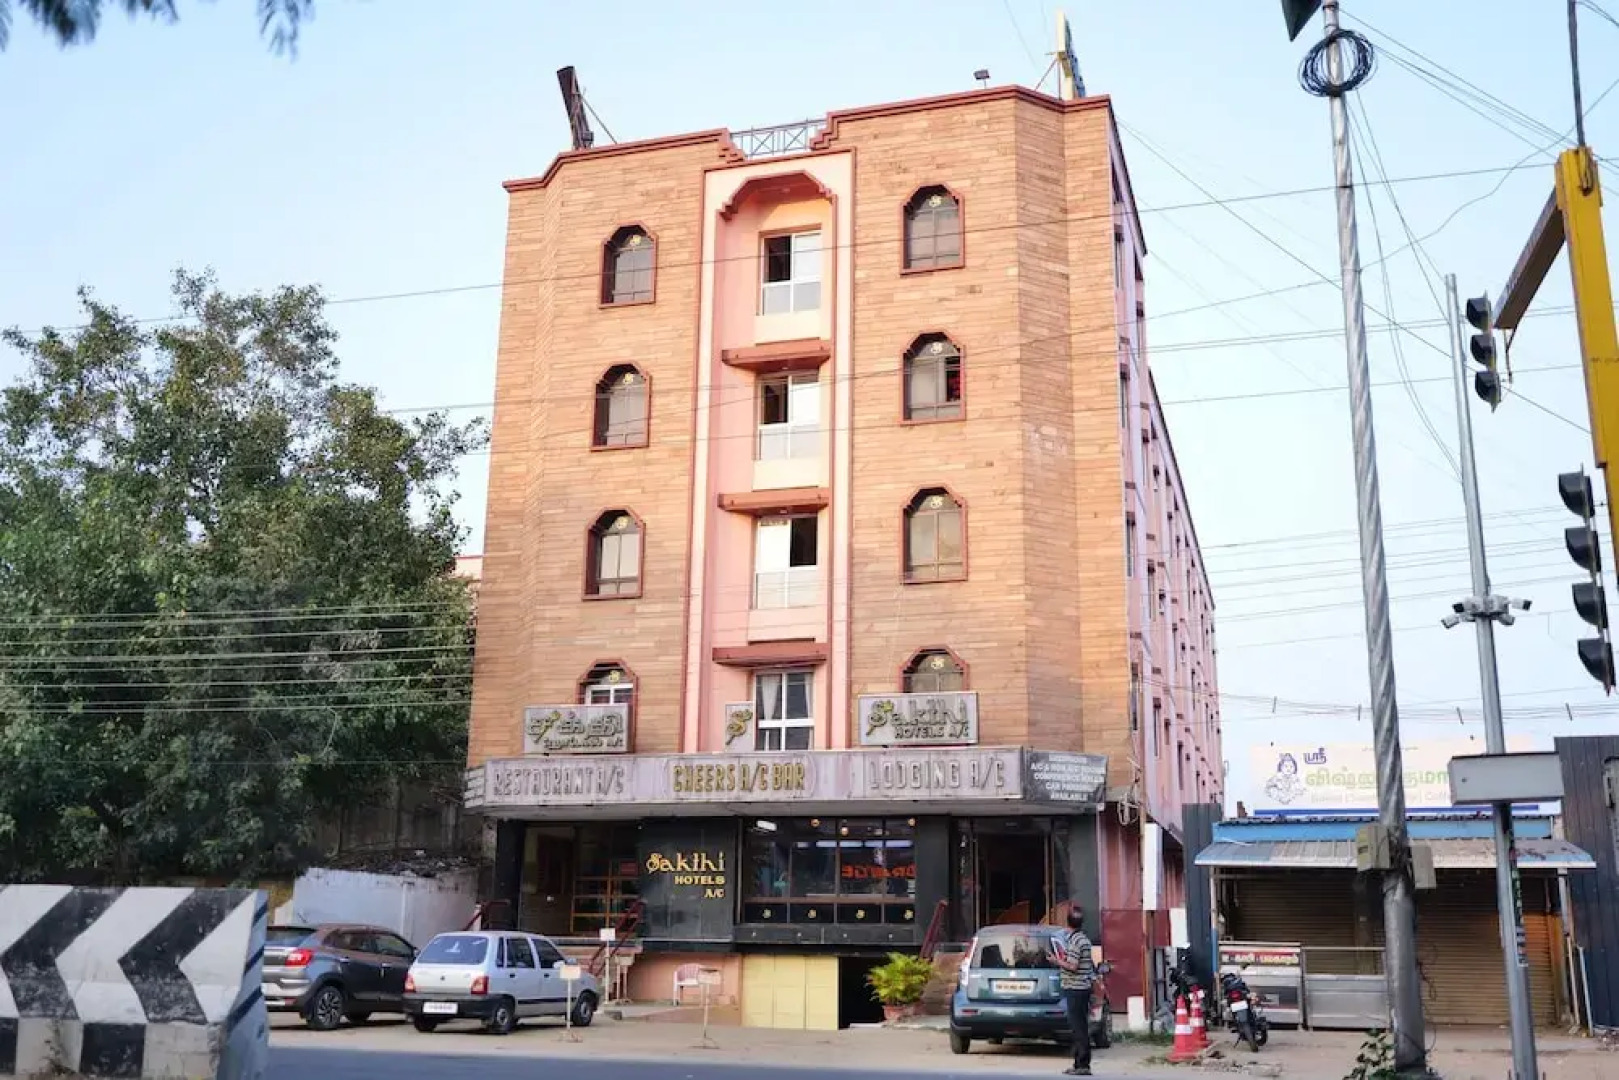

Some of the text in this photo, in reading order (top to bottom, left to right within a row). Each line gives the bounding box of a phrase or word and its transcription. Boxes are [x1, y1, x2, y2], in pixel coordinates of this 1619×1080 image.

[895, 726, 944, 738] HOTELS
[493, 765, 624, 795] RESTAURANT A/C
[673, 761, 805, 792] CHEERS A/C BAR
[870, 757, 1004, 790] LODGING A/C
[646, 852, 725, 874] Sakthi
[674, 875, 725, 885] HOTELS
[704, 888, 725, 898] A/C
